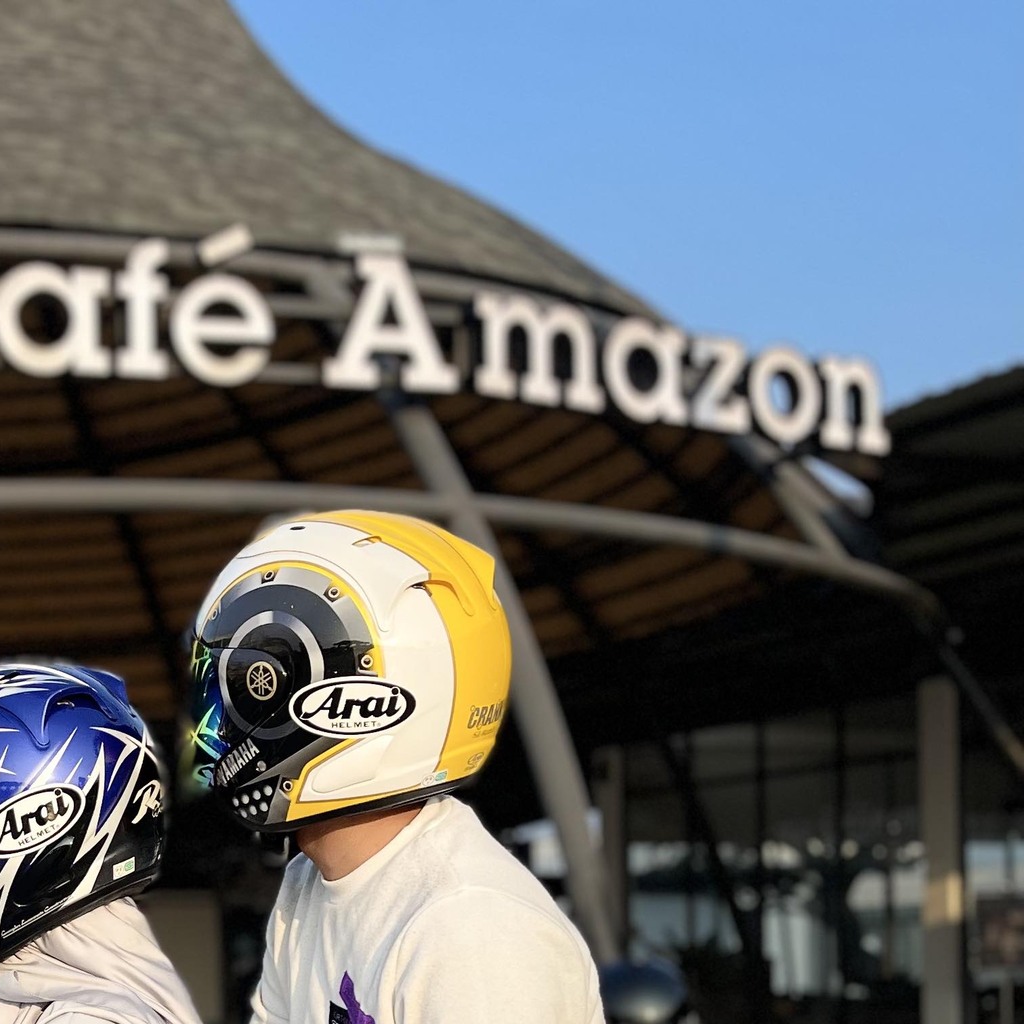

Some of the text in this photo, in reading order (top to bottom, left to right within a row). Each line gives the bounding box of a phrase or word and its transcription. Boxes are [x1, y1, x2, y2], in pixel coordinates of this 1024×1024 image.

[301, 687, 402, 720] Arai
[331, 720, 378, 729] HELMET
[18, 825, 57, 847] HELMET
